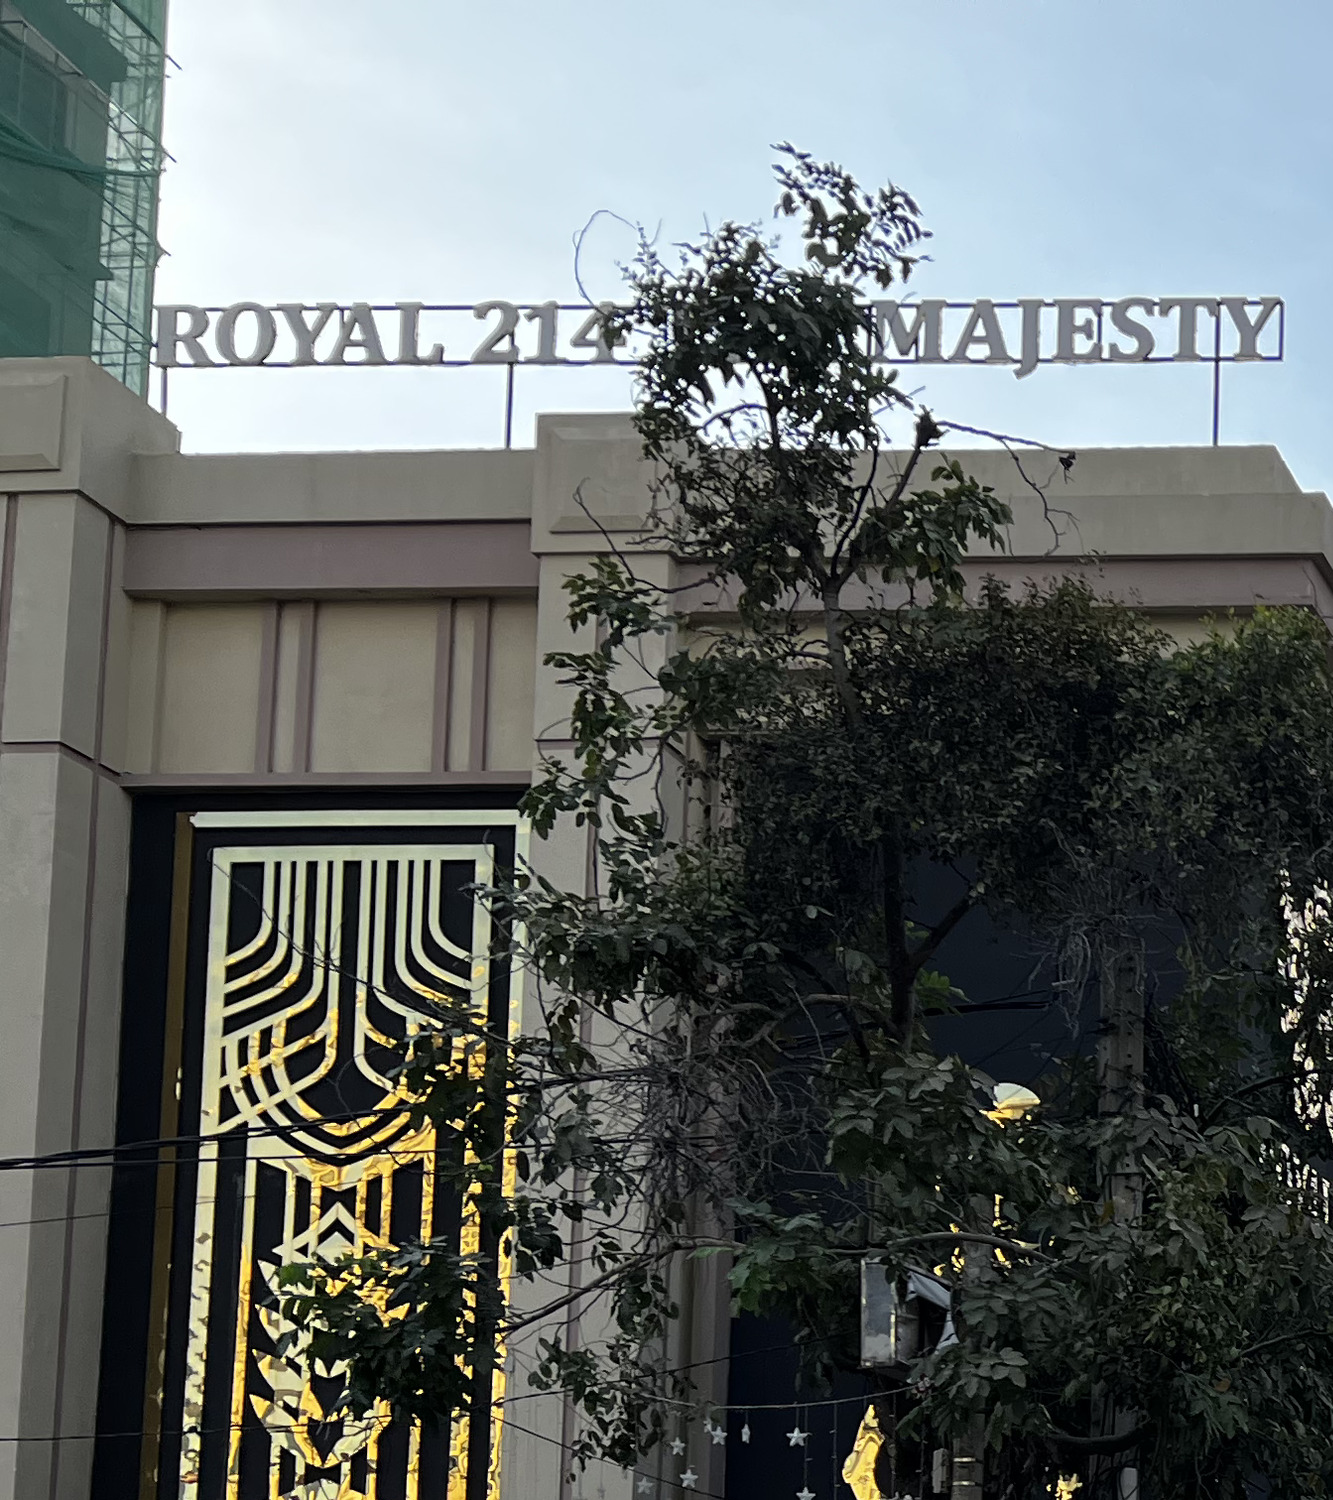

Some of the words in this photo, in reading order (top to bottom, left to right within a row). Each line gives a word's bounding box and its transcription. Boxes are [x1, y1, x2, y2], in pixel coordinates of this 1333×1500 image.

[153, 301, 444, 366] ROYAL
[470, 301, 627, 365] 214
[869, 297, 1284, 377] MAJESTY
